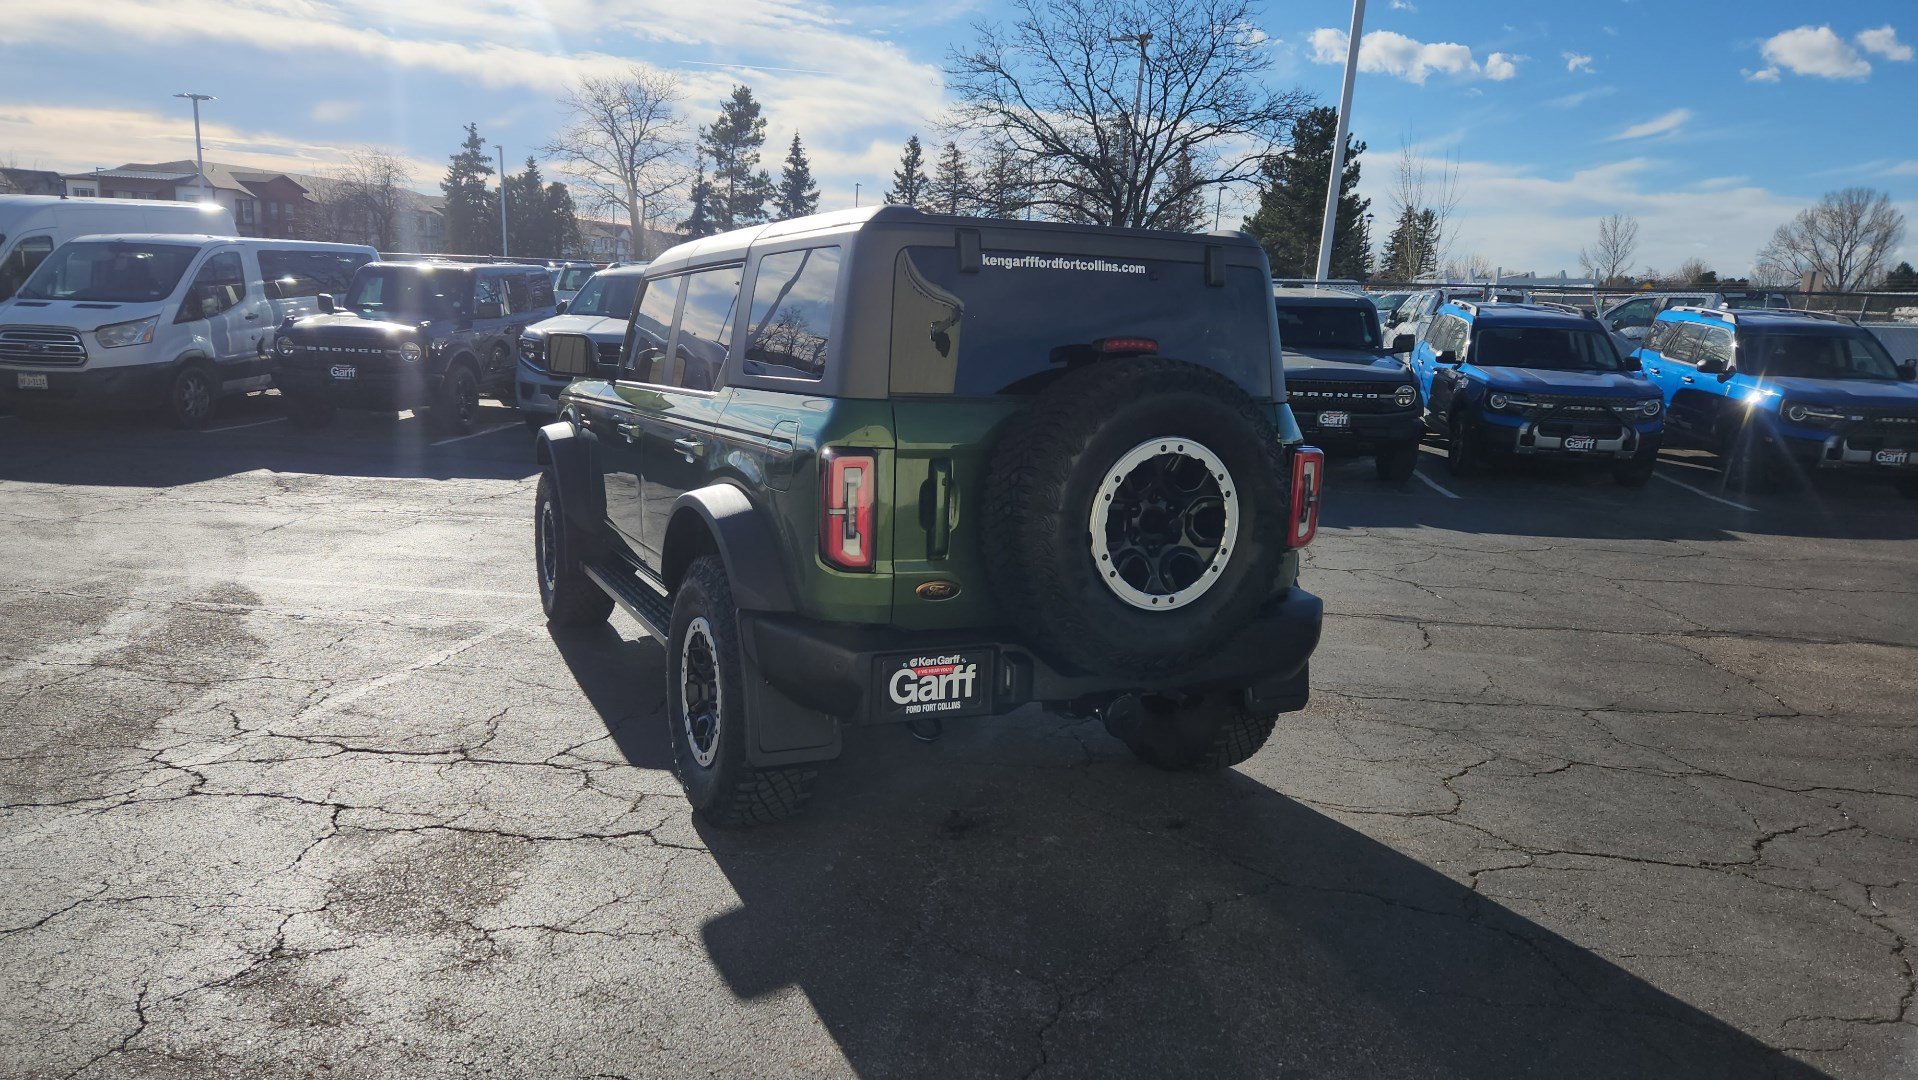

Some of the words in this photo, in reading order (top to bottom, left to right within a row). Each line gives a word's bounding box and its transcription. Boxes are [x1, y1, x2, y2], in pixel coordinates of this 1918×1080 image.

[982, 253, 1146, 274] kengarfffordfortcollins.com
[306, 345, 382, 354] BRONCO
[330, 366, 356, 377] Garff
[1292, 391, 1378, 399] BRONCO
[1319, 413, 1348, 425] Garff
[1564, 437, 1595, 449] Garff
[1875, 450, 1907, 463] Garff
[918, 656, 937, 667] Ken
[937, 654, 961, 666] Garff
[889, 663, 977, 705] Garff
[905, 705, 922, 714] FORD
[922, 703, 937, 713] FORT
[937, 701, 961, 711] COLLINS
